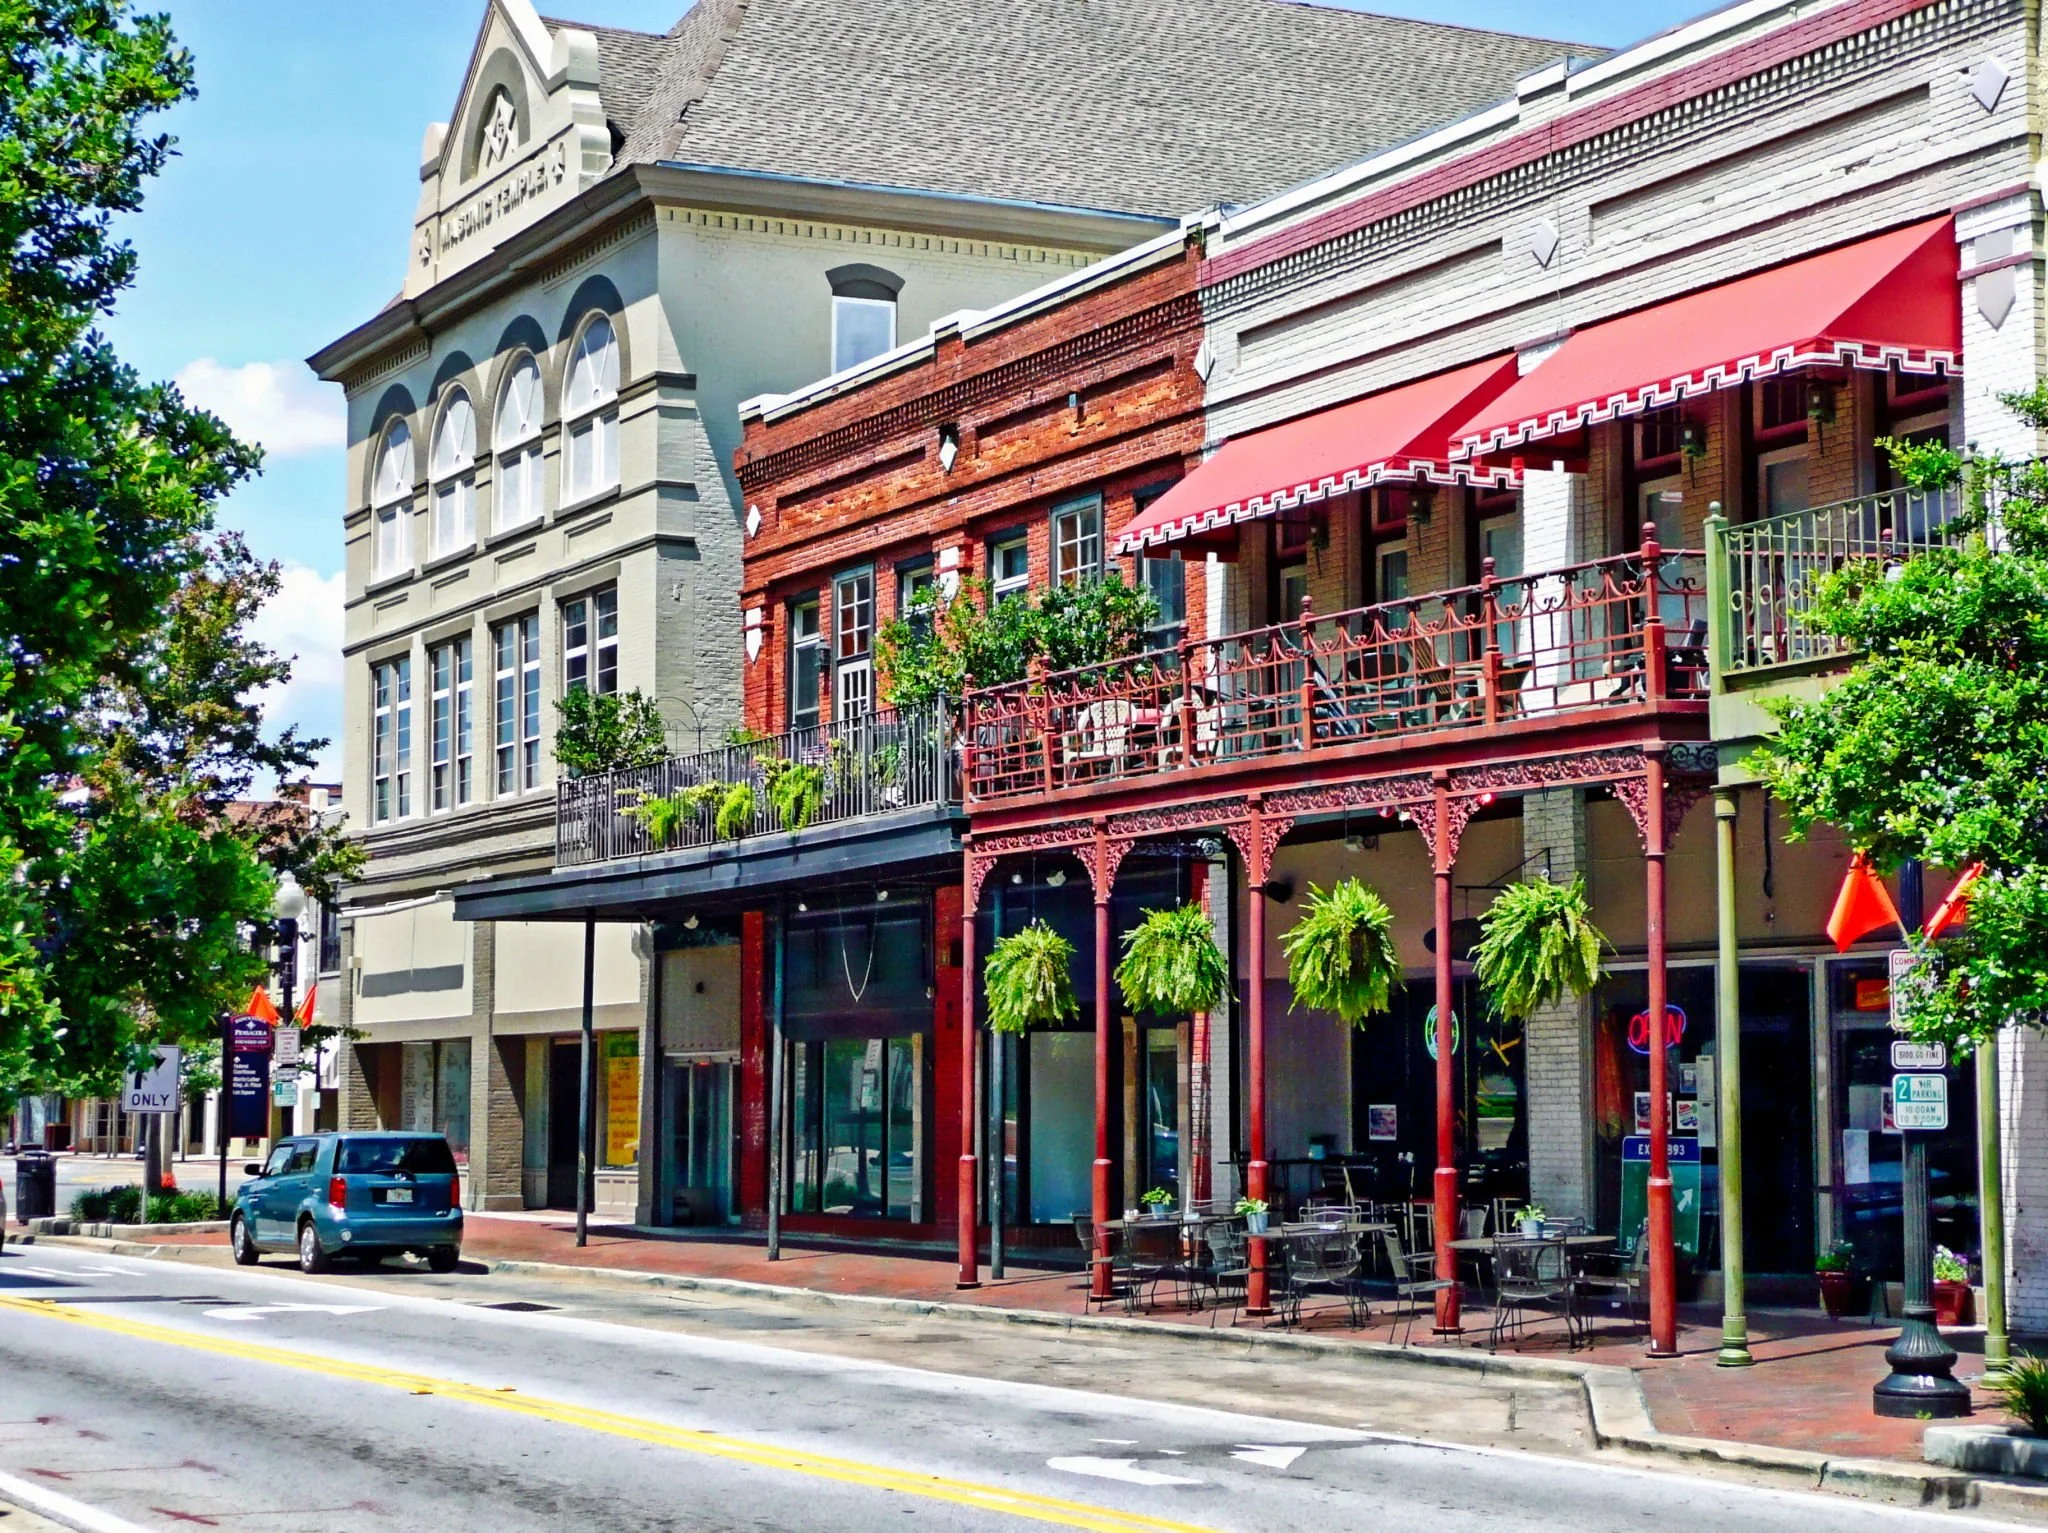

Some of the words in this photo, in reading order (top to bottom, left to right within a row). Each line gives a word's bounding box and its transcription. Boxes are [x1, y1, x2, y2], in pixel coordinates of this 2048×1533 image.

[441, 200, 493, 253] MASONIC
[495, 163, 549, 218] TEMPLE
[1629, 1014, 1683, 1045] OPN
[1926, 1051, 1940, 1059] FINE
[1898, 1079, 1908, 1099] 2
[1912, 1090, 1942, 1099] PARKING
[131, 1093, 170, 1107] ONLY
